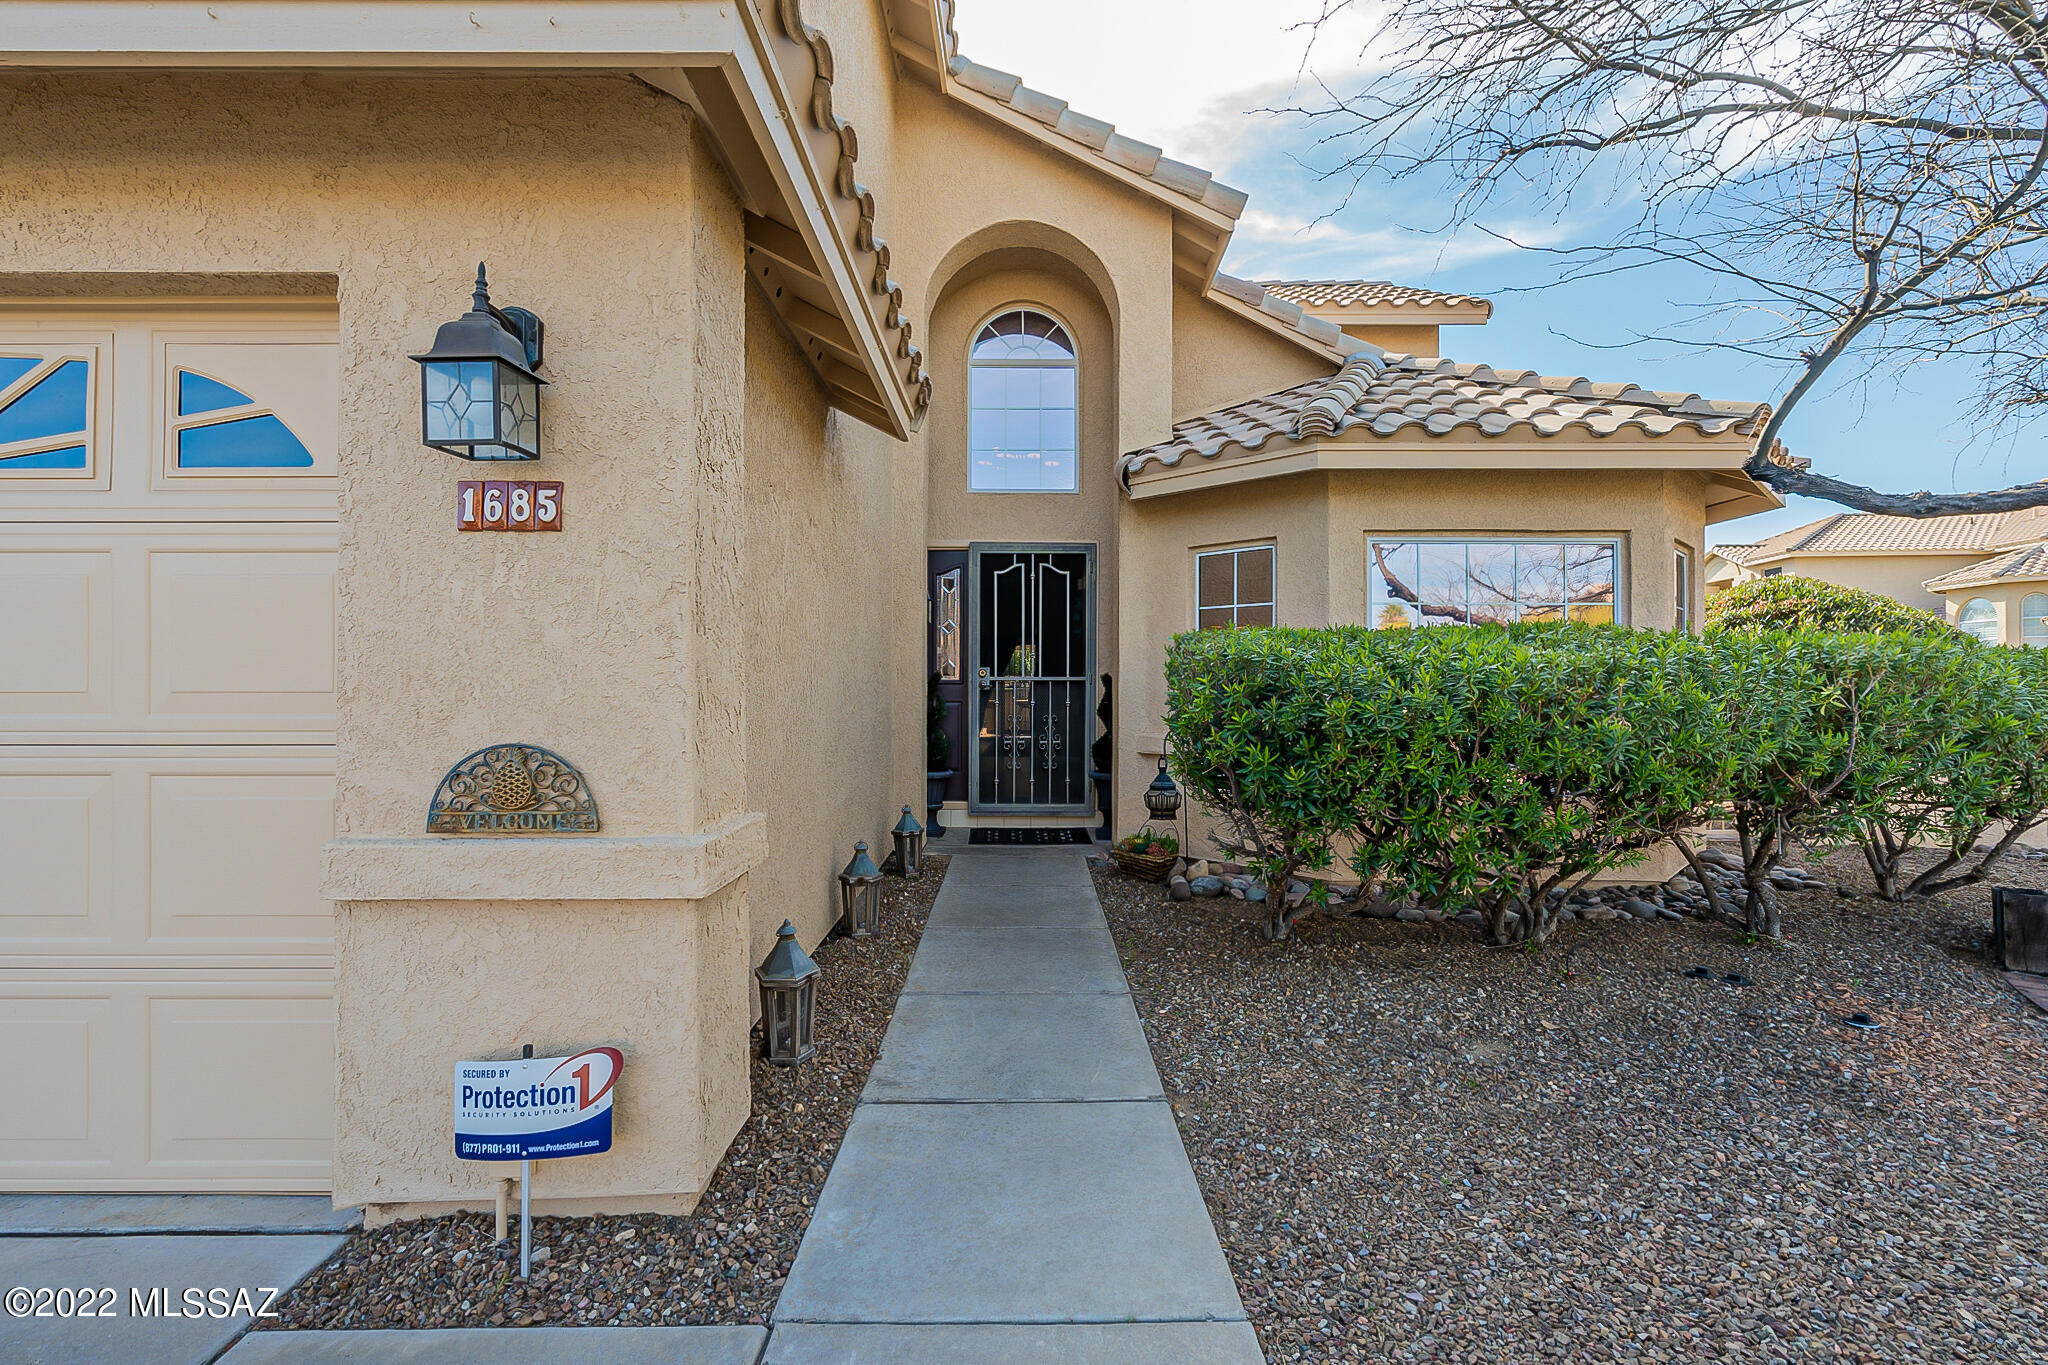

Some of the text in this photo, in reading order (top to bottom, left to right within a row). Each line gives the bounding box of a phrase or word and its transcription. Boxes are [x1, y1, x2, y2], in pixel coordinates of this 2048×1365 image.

[462, 488, 557, 522] 1685
[462, 1069, 510, 1079] SECURED BY
[462, 1082, 576, 1109] Protection
[513, 1106, 575, 1117] SOLUTIONS
[527, 1139, 599, 1153] www.Protection1.com
